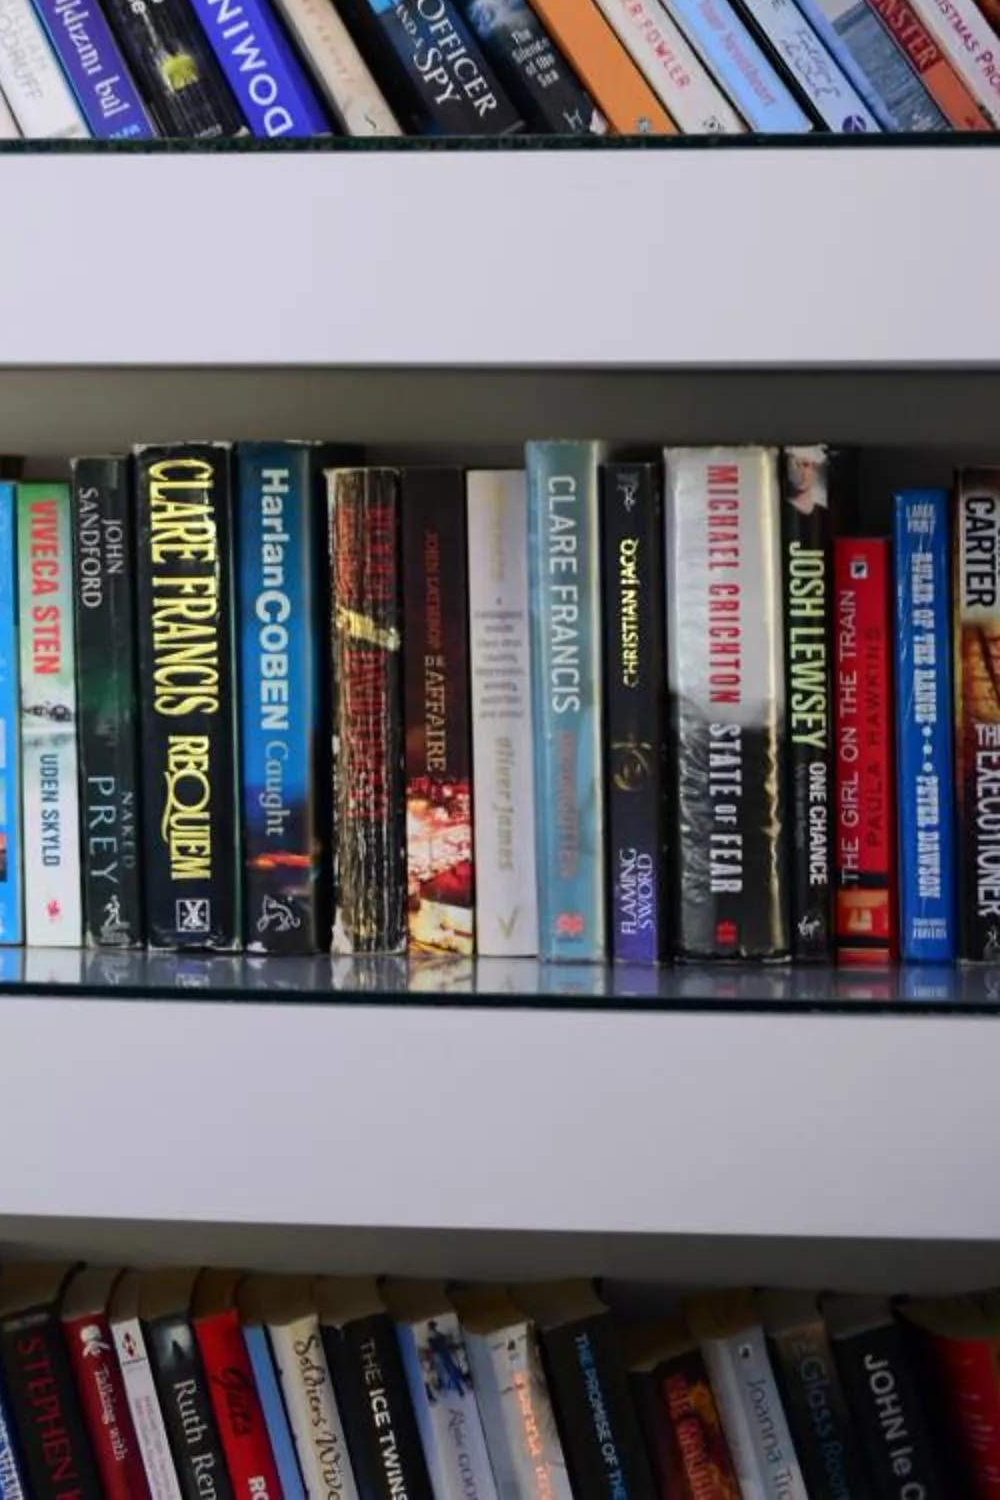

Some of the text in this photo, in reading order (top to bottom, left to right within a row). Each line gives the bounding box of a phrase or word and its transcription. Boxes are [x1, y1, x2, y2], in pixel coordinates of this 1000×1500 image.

[95, 74, 131, 118] bul
[636, 13, 696, 91] FOWLER
[77, 486, 104, 610] SANDFORD
[103, 518, 124, 575] JOHN
[546, 474, 579, 575] CLARE
[963, 497, 999, 609] CARTER
[27, 500, 61, 677] VIVECA STEN
[147, 456, 219, 718] CLARE FRANCIS
[254, 467, 292, 731] Harlan COBEN
[706, 464, 742, 706] MICHAEL CRICHTON
[551, 583, 582, 714] FRANCIS
[787, 542, 828, 751] JOSH LEWSEY
[424, 670, 448, 773] AFFAIRE
[839, 589, 860, 886] THE GIRL ON THE TRAIN
[38, 753, 61, 868] UDEN SKYLD
[86, 774, 120, 885] PREY
[160, 734, 212, 882] REQUIEM
[258, 738, 288, 838] Caught
[709, 723, 744, 894] STATE OF FEAR
[807, 760, 829, 887] ONE CHANCE
[975, 746, 1000, 918] EXECUTIONER
[621, 847, 638, 936] FLAMING
[637, 851, 655, 931] SWORD
[17, 1335, 73, 1483] STEPHEN
[172, 1378, 209, 1445] Ruth
[359, 1337, 384, 1386] THE
[368, 1387, 392, 1428] ICE
[863, 1353, 915, 1477] JOHN le
[747, 1378, 782, 1463] Joanna
